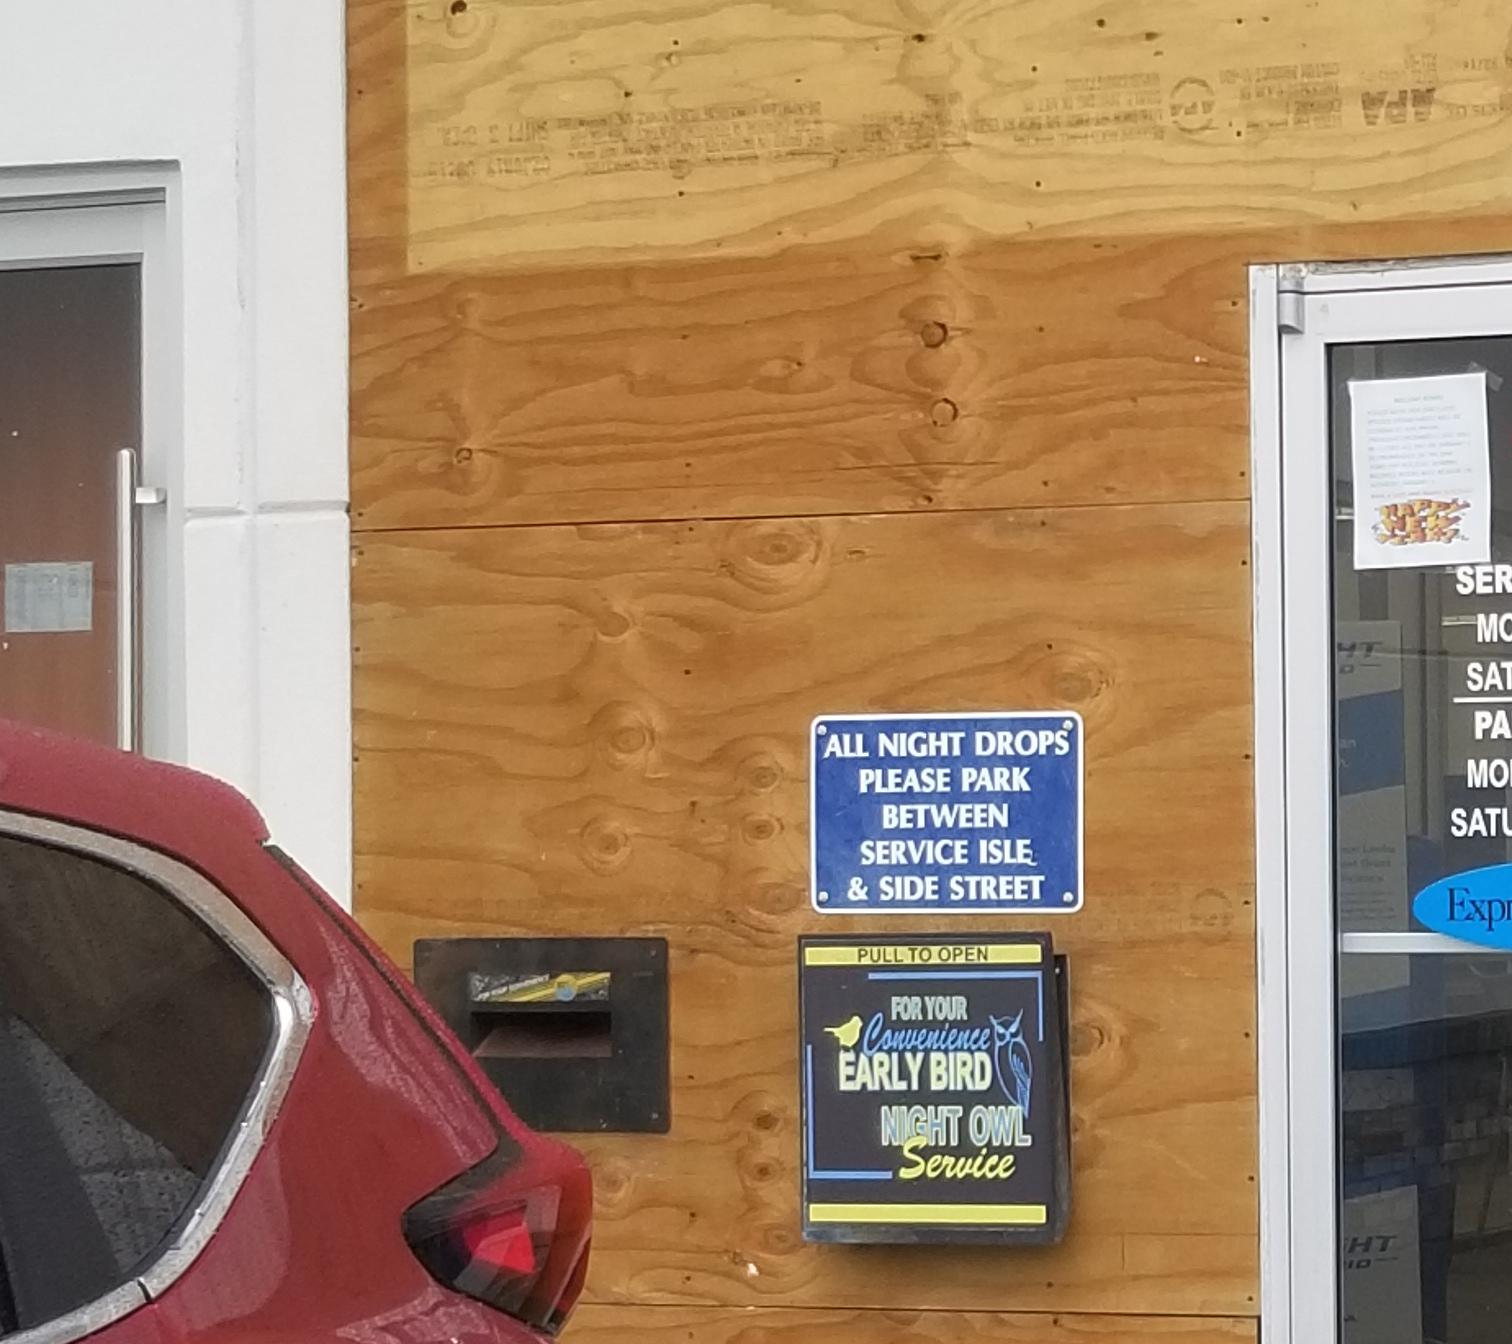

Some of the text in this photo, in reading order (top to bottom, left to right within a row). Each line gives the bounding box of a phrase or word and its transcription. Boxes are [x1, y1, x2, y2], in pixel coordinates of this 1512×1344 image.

[823, 730, 1070, 758] ALL NIGHT DROPS
[859, 766, 1031, 793] PLEASE PARK
[882, 802, 1009, 829] BETWEEN
[860, 839, 1034, 865] SERVICE ISLE
[847, 875, 1045, 901] & SIDE STREET
[857, 946, 988, 963] PULL TO OPEN
[890, 996, 968, 1020] FOR YOUR
[862, 1012, 991, 1057] Convenience
[838, 1050, 993, 1092] EARLY BIRD
[881, 1105, 1032, 1146] NIGHT OWL
[899, 1136, 1016, 1180] Service
